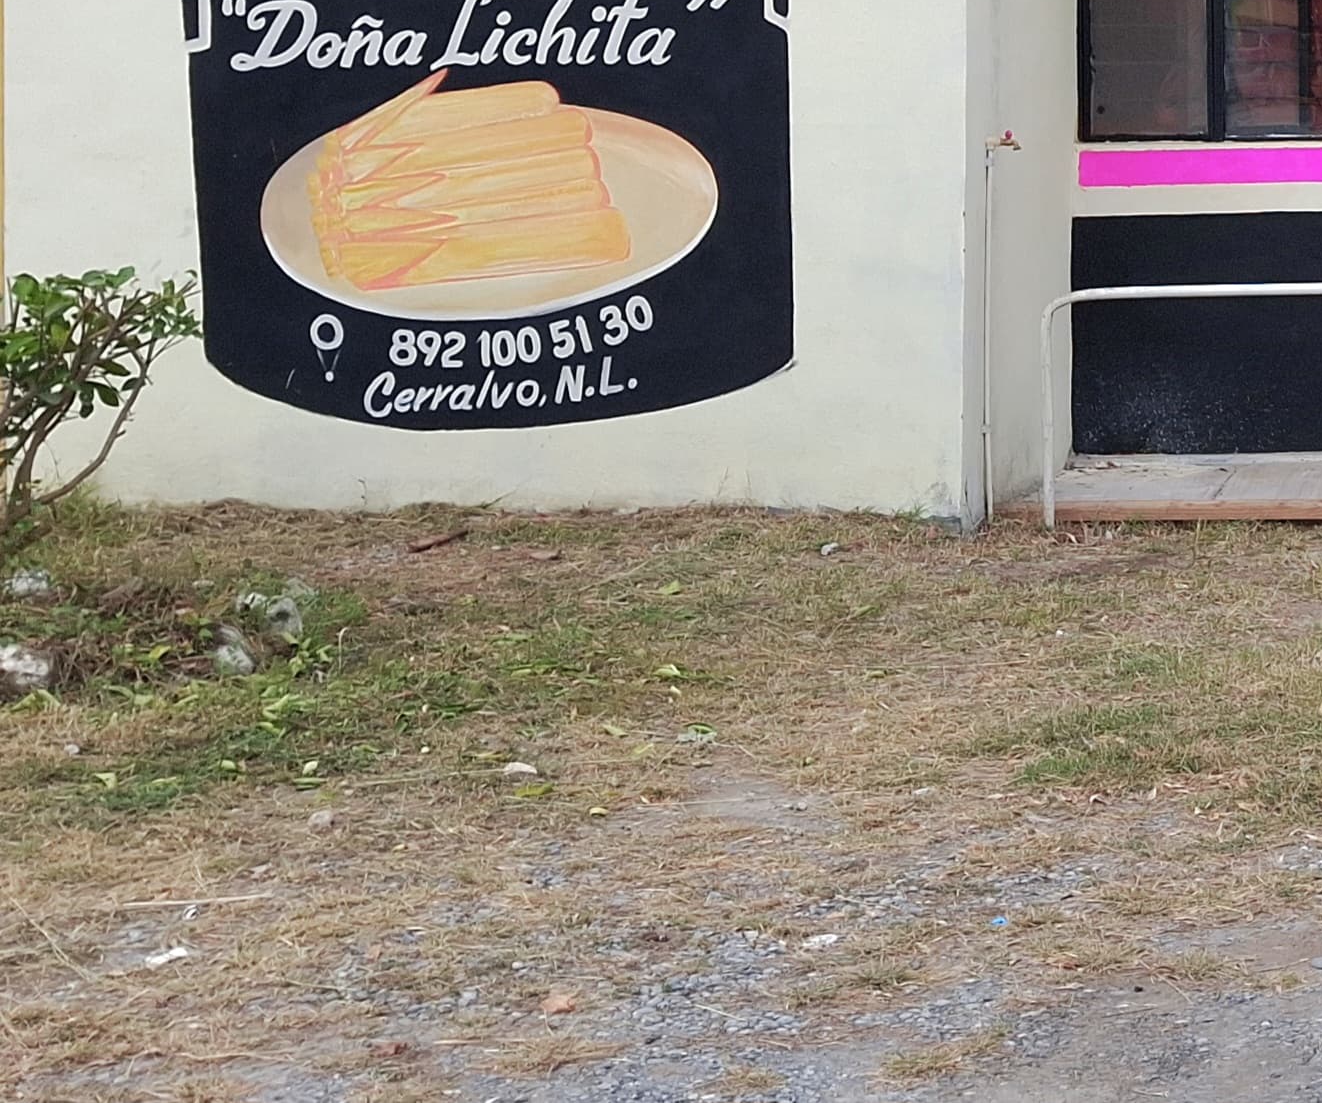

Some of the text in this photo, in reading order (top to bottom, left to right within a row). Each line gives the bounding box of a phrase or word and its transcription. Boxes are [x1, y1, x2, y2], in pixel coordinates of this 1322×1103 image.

[388, 294, 655, 369] 892 100 51 30
[363, 355, 639, 419] Cerralvo, N.L.
